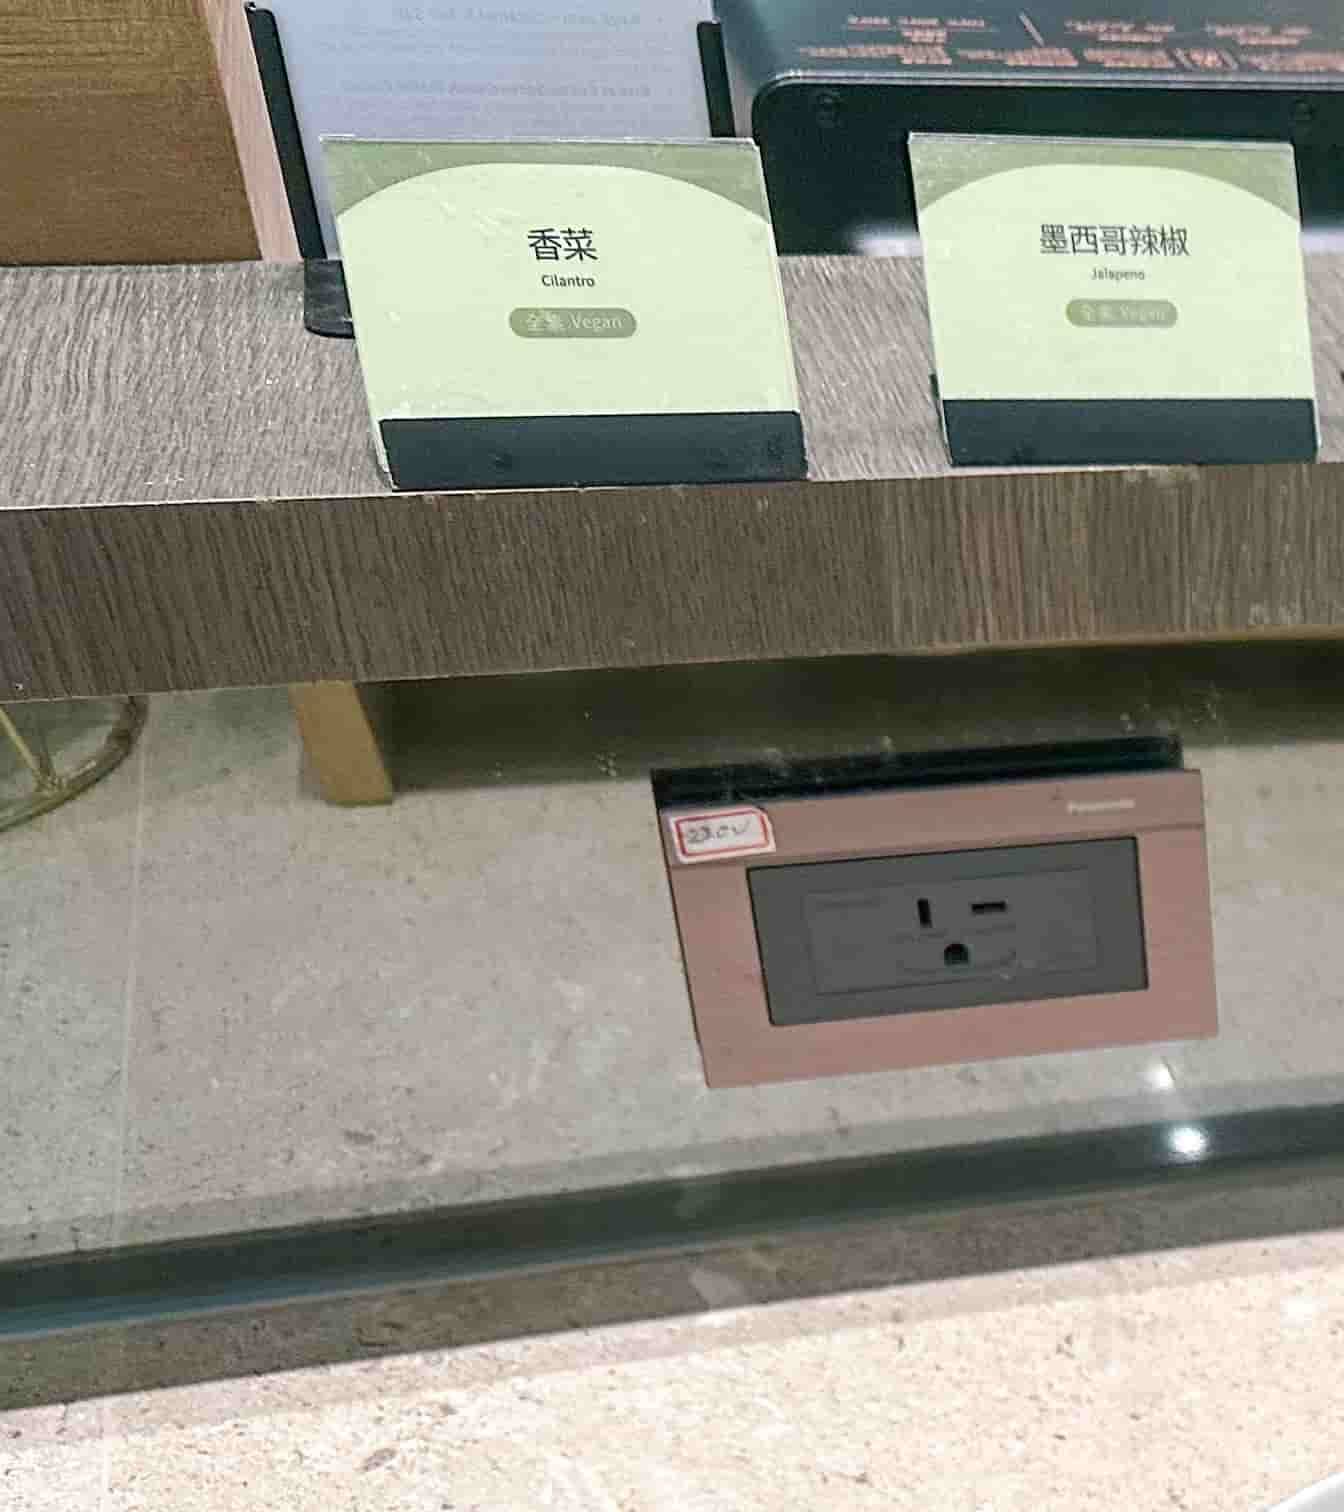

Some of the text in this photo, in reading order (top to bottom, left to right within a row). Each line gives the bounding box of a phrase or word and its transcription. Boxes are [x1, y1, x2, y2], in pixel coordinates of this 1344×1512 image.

[528, 228, 598, 260] 香菜
[1040, 224, 1190, 256] 墨西哥辣椒
[542, 274, 595, 287] Cilantro
